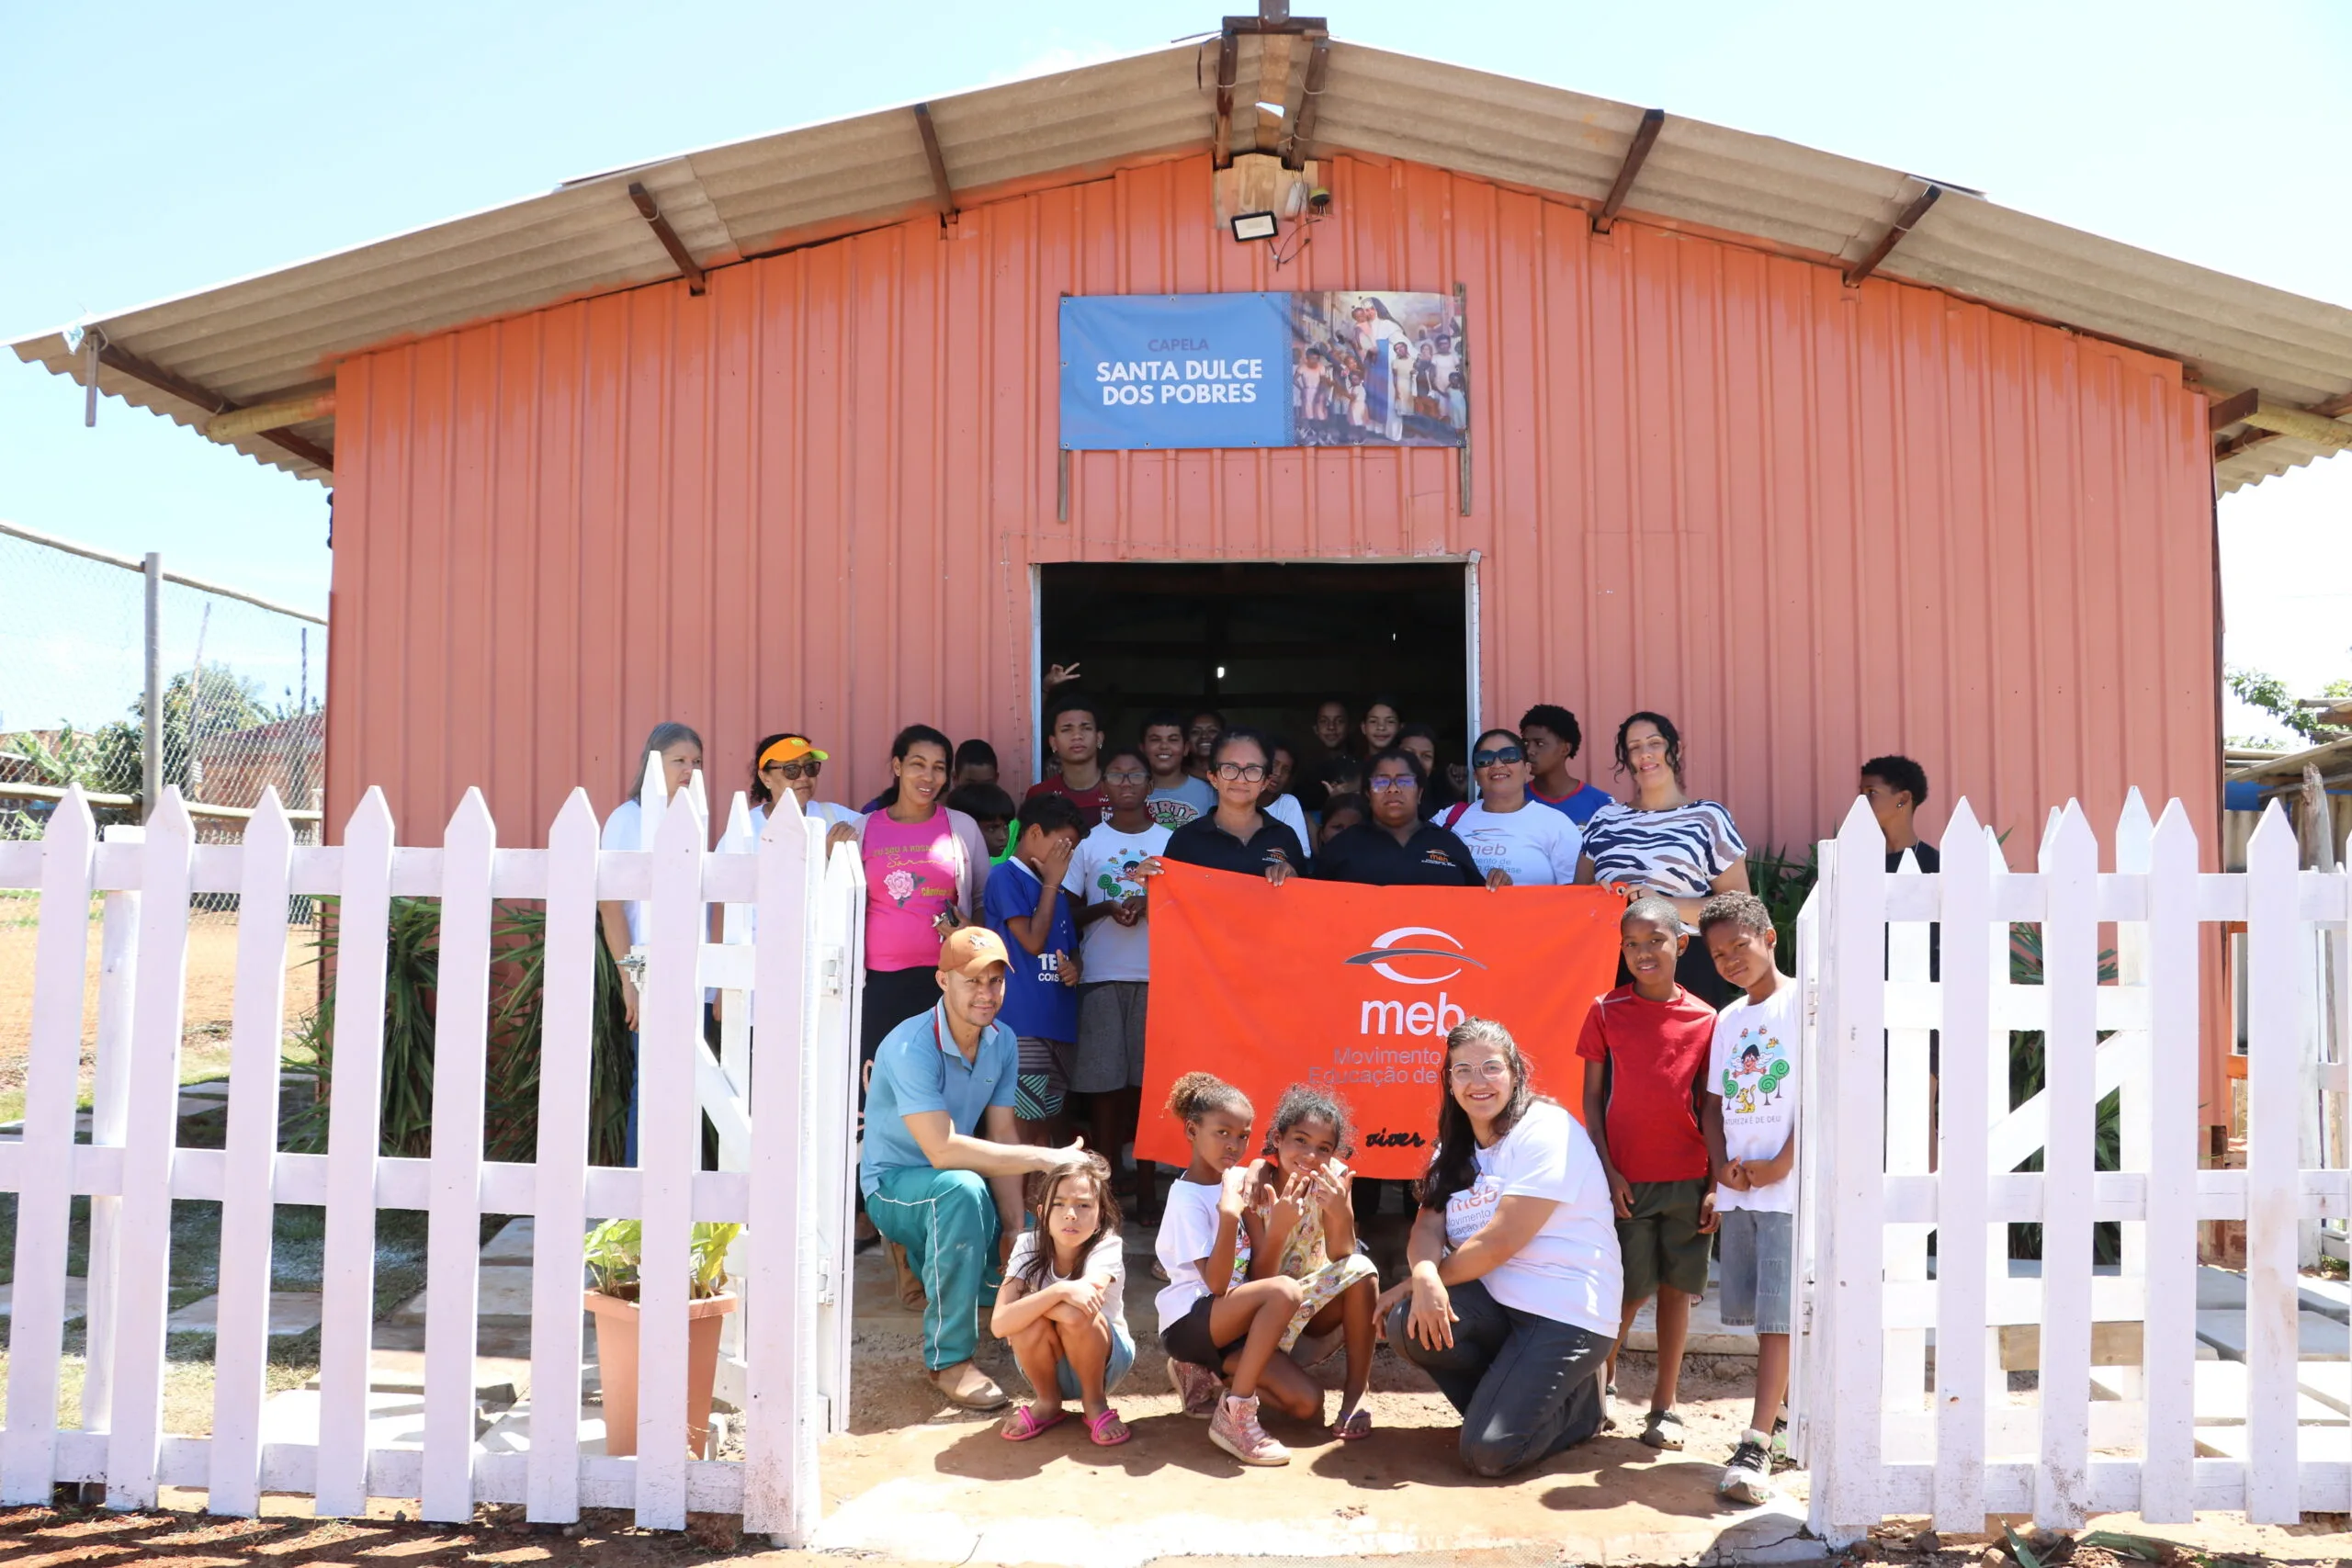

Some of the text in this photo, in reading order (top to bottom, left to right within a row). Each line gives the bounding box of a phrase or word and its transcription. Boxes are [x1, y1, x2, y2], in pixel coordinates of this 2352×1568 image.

[1148, 338, 1210, 353] CAPELA
[1096, 359, 1262, 382] SANTA DULCE
[1102, 383, 1257, 405] DOS POBRES
[1360, 992, 1465, 1037] meb
[1334, 1047, 1442, 1066] Movimento
[1308, 1066, 1438, 1087] Educação de
[1449, 1210, 1491, 1226] ovimento
